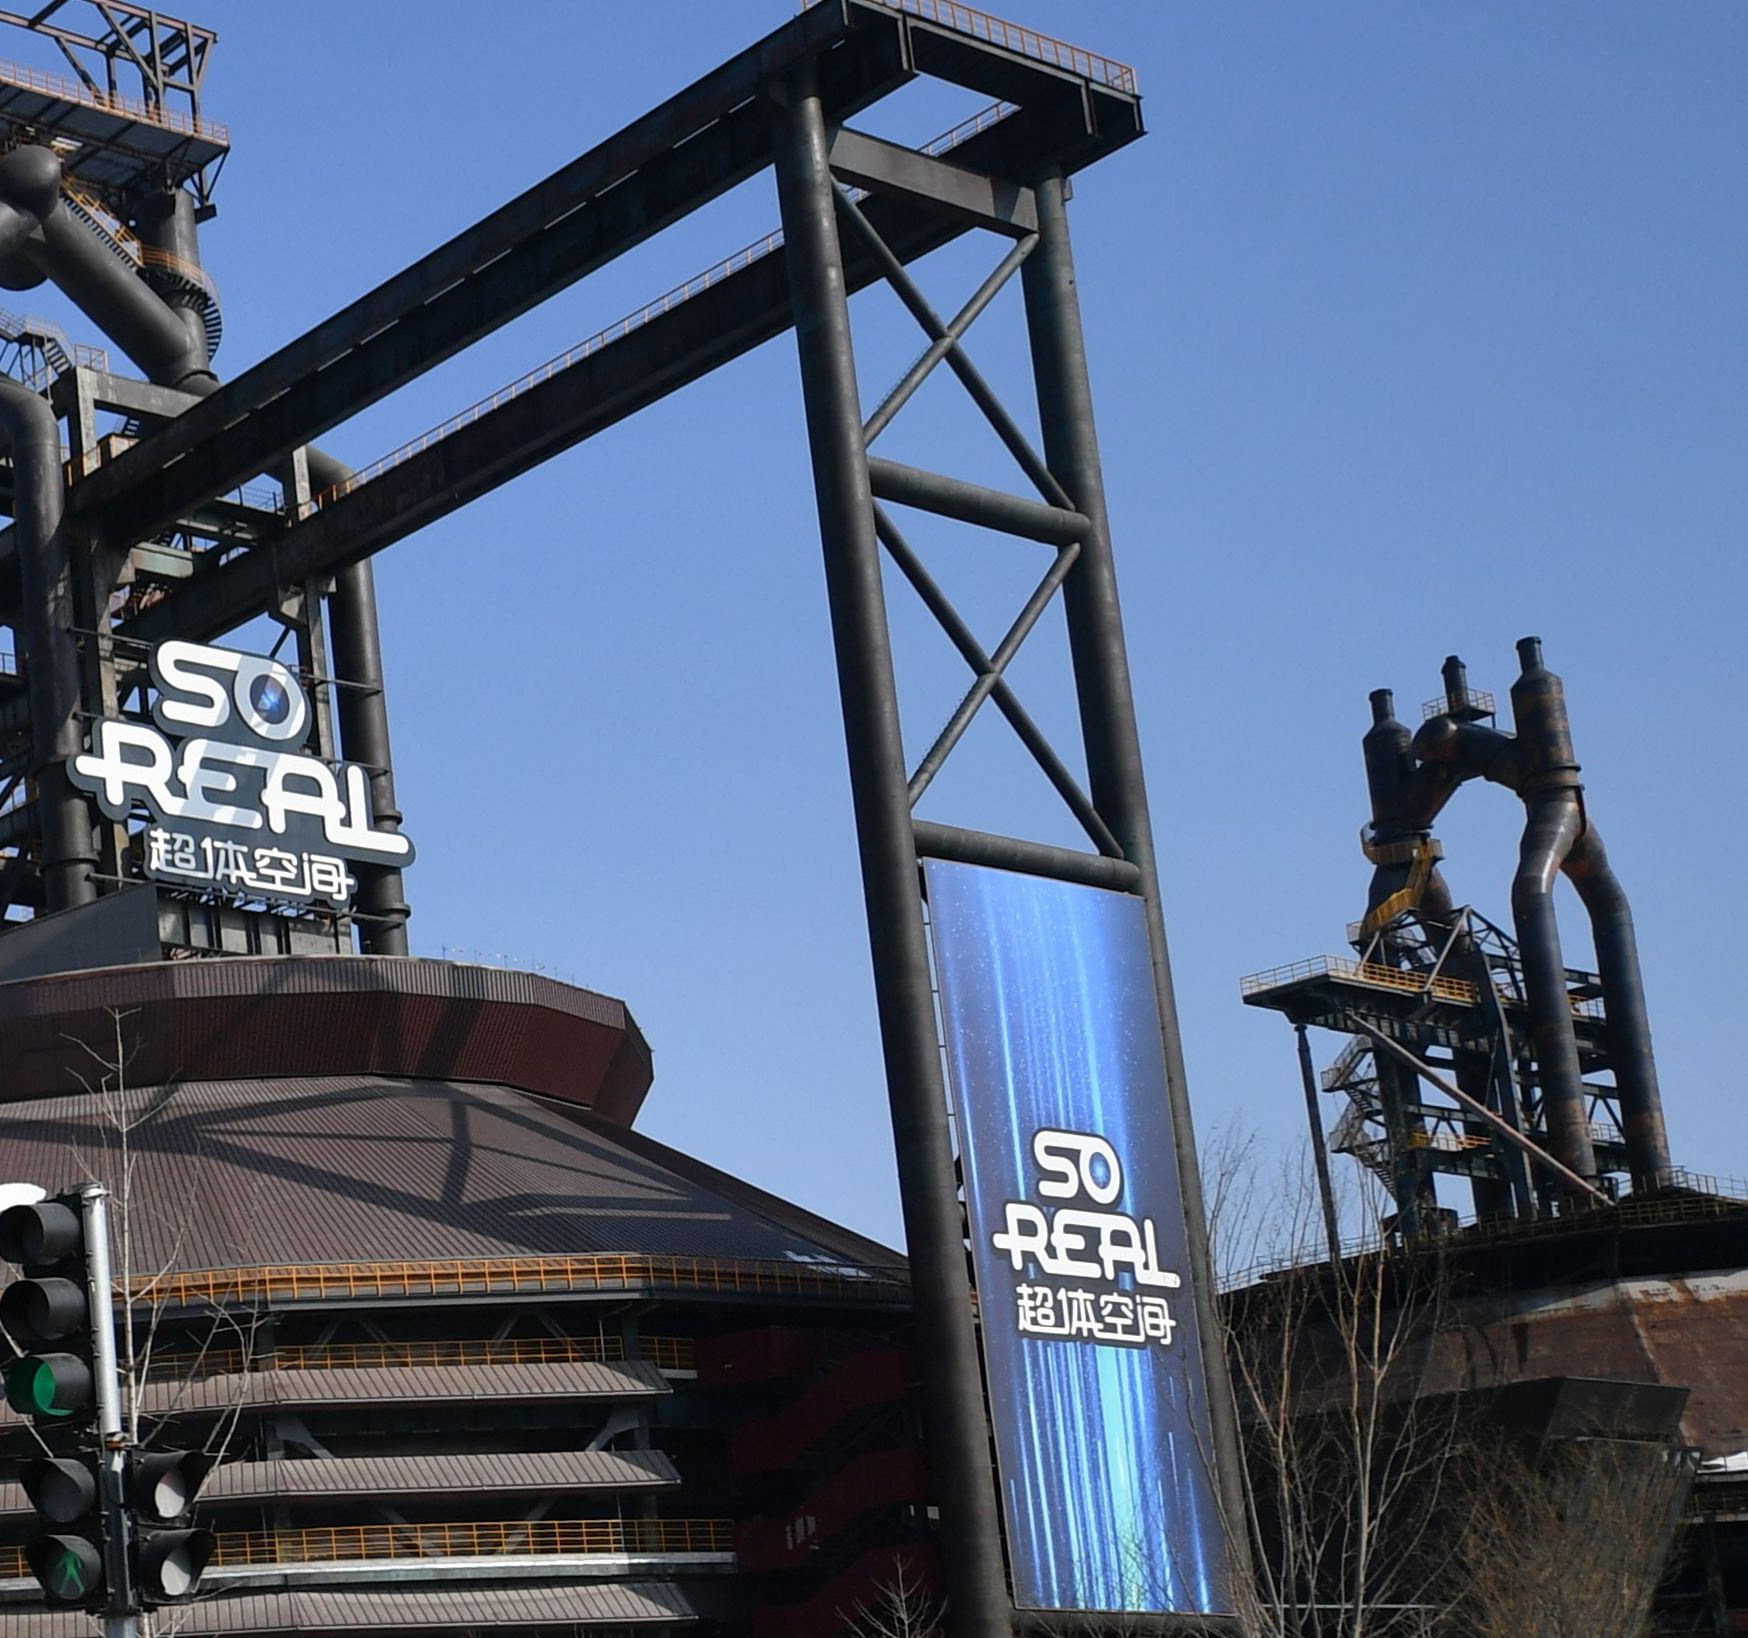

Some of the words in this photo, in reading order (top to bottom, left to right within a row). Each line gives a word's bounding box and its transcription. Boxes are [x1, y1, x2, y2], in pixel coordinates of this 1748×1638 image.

[157, 639, 307, 741] SO
[75, 720, 409, 855] REAL
[149, 828, 355, 901] 超体空间
[1033, 1130, 1122, 1205] SO
[992, 1202, 1181, 1289] REAL
[1015, 1283, 1177, 1346] 超体空间
